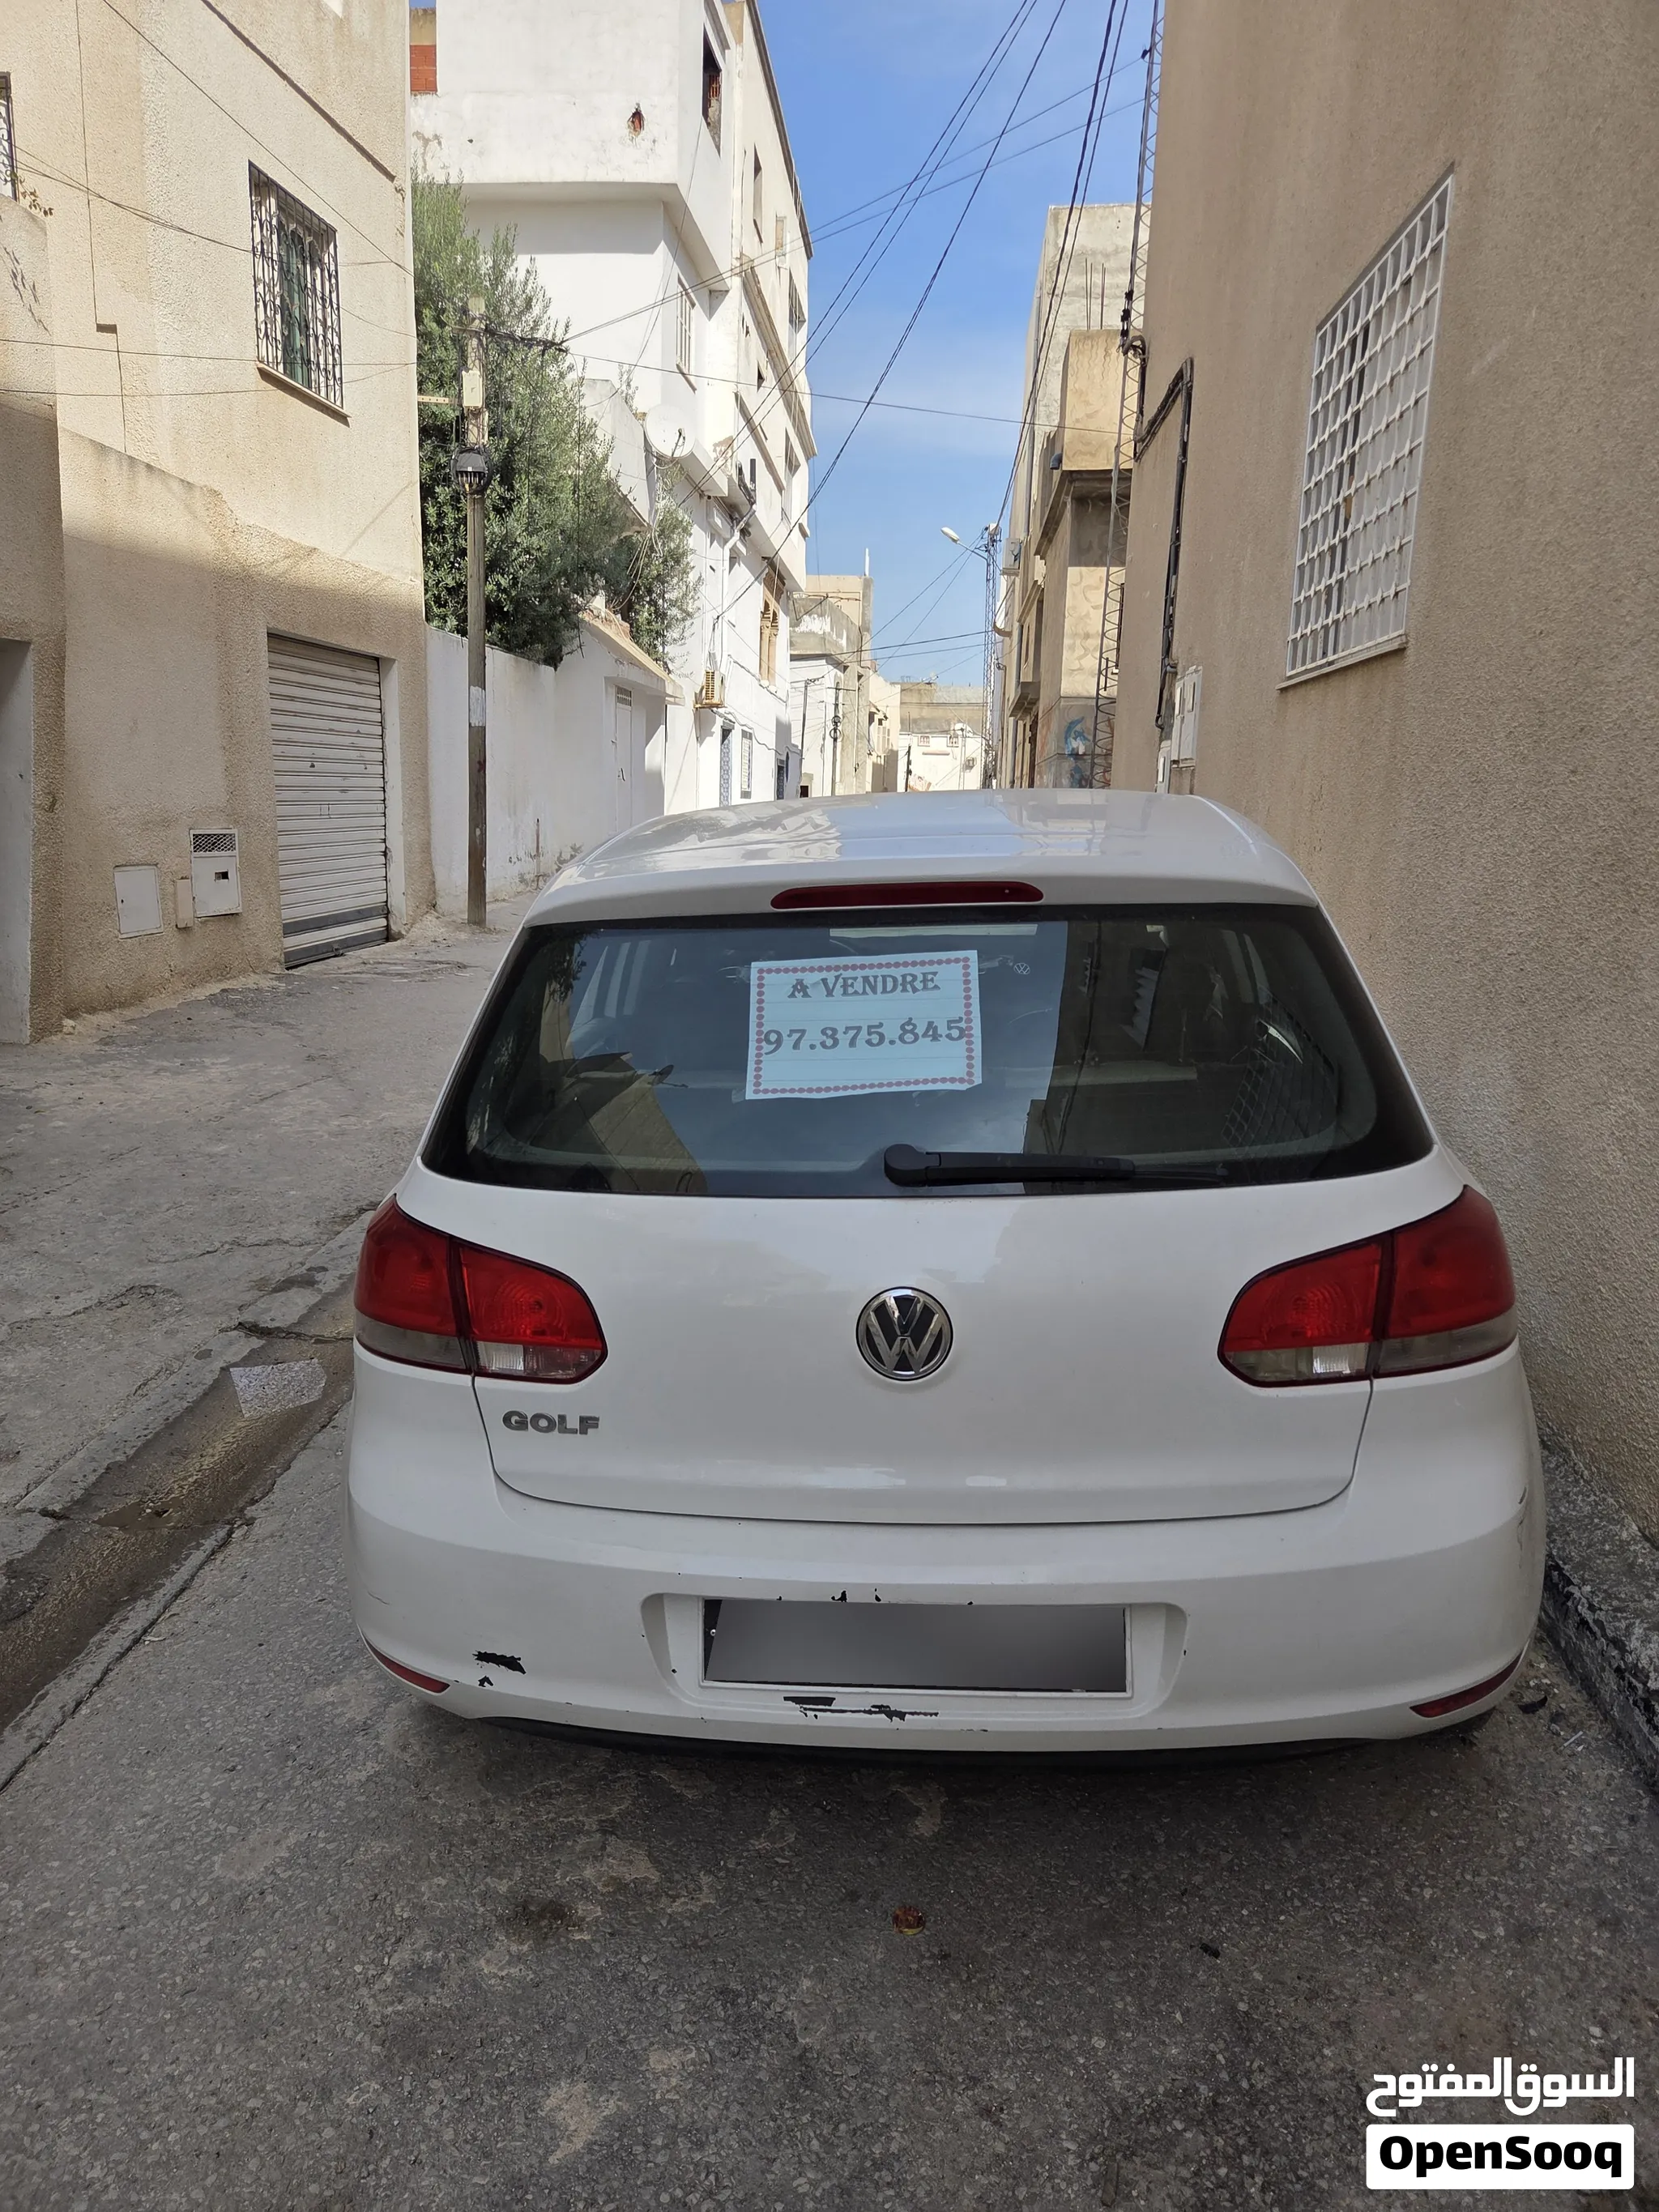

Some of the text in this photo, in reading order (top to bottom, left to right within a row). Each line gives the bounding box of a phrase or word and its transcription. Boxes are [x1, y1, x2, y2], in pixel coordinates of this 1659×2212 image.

[787, 971, 941, 998] A VENDRE
[763, 1016, 966, 1055] 97.375.845
[860, 1290, 949, 1378] VW
[502, 1410, 599, 1435] GOLF
